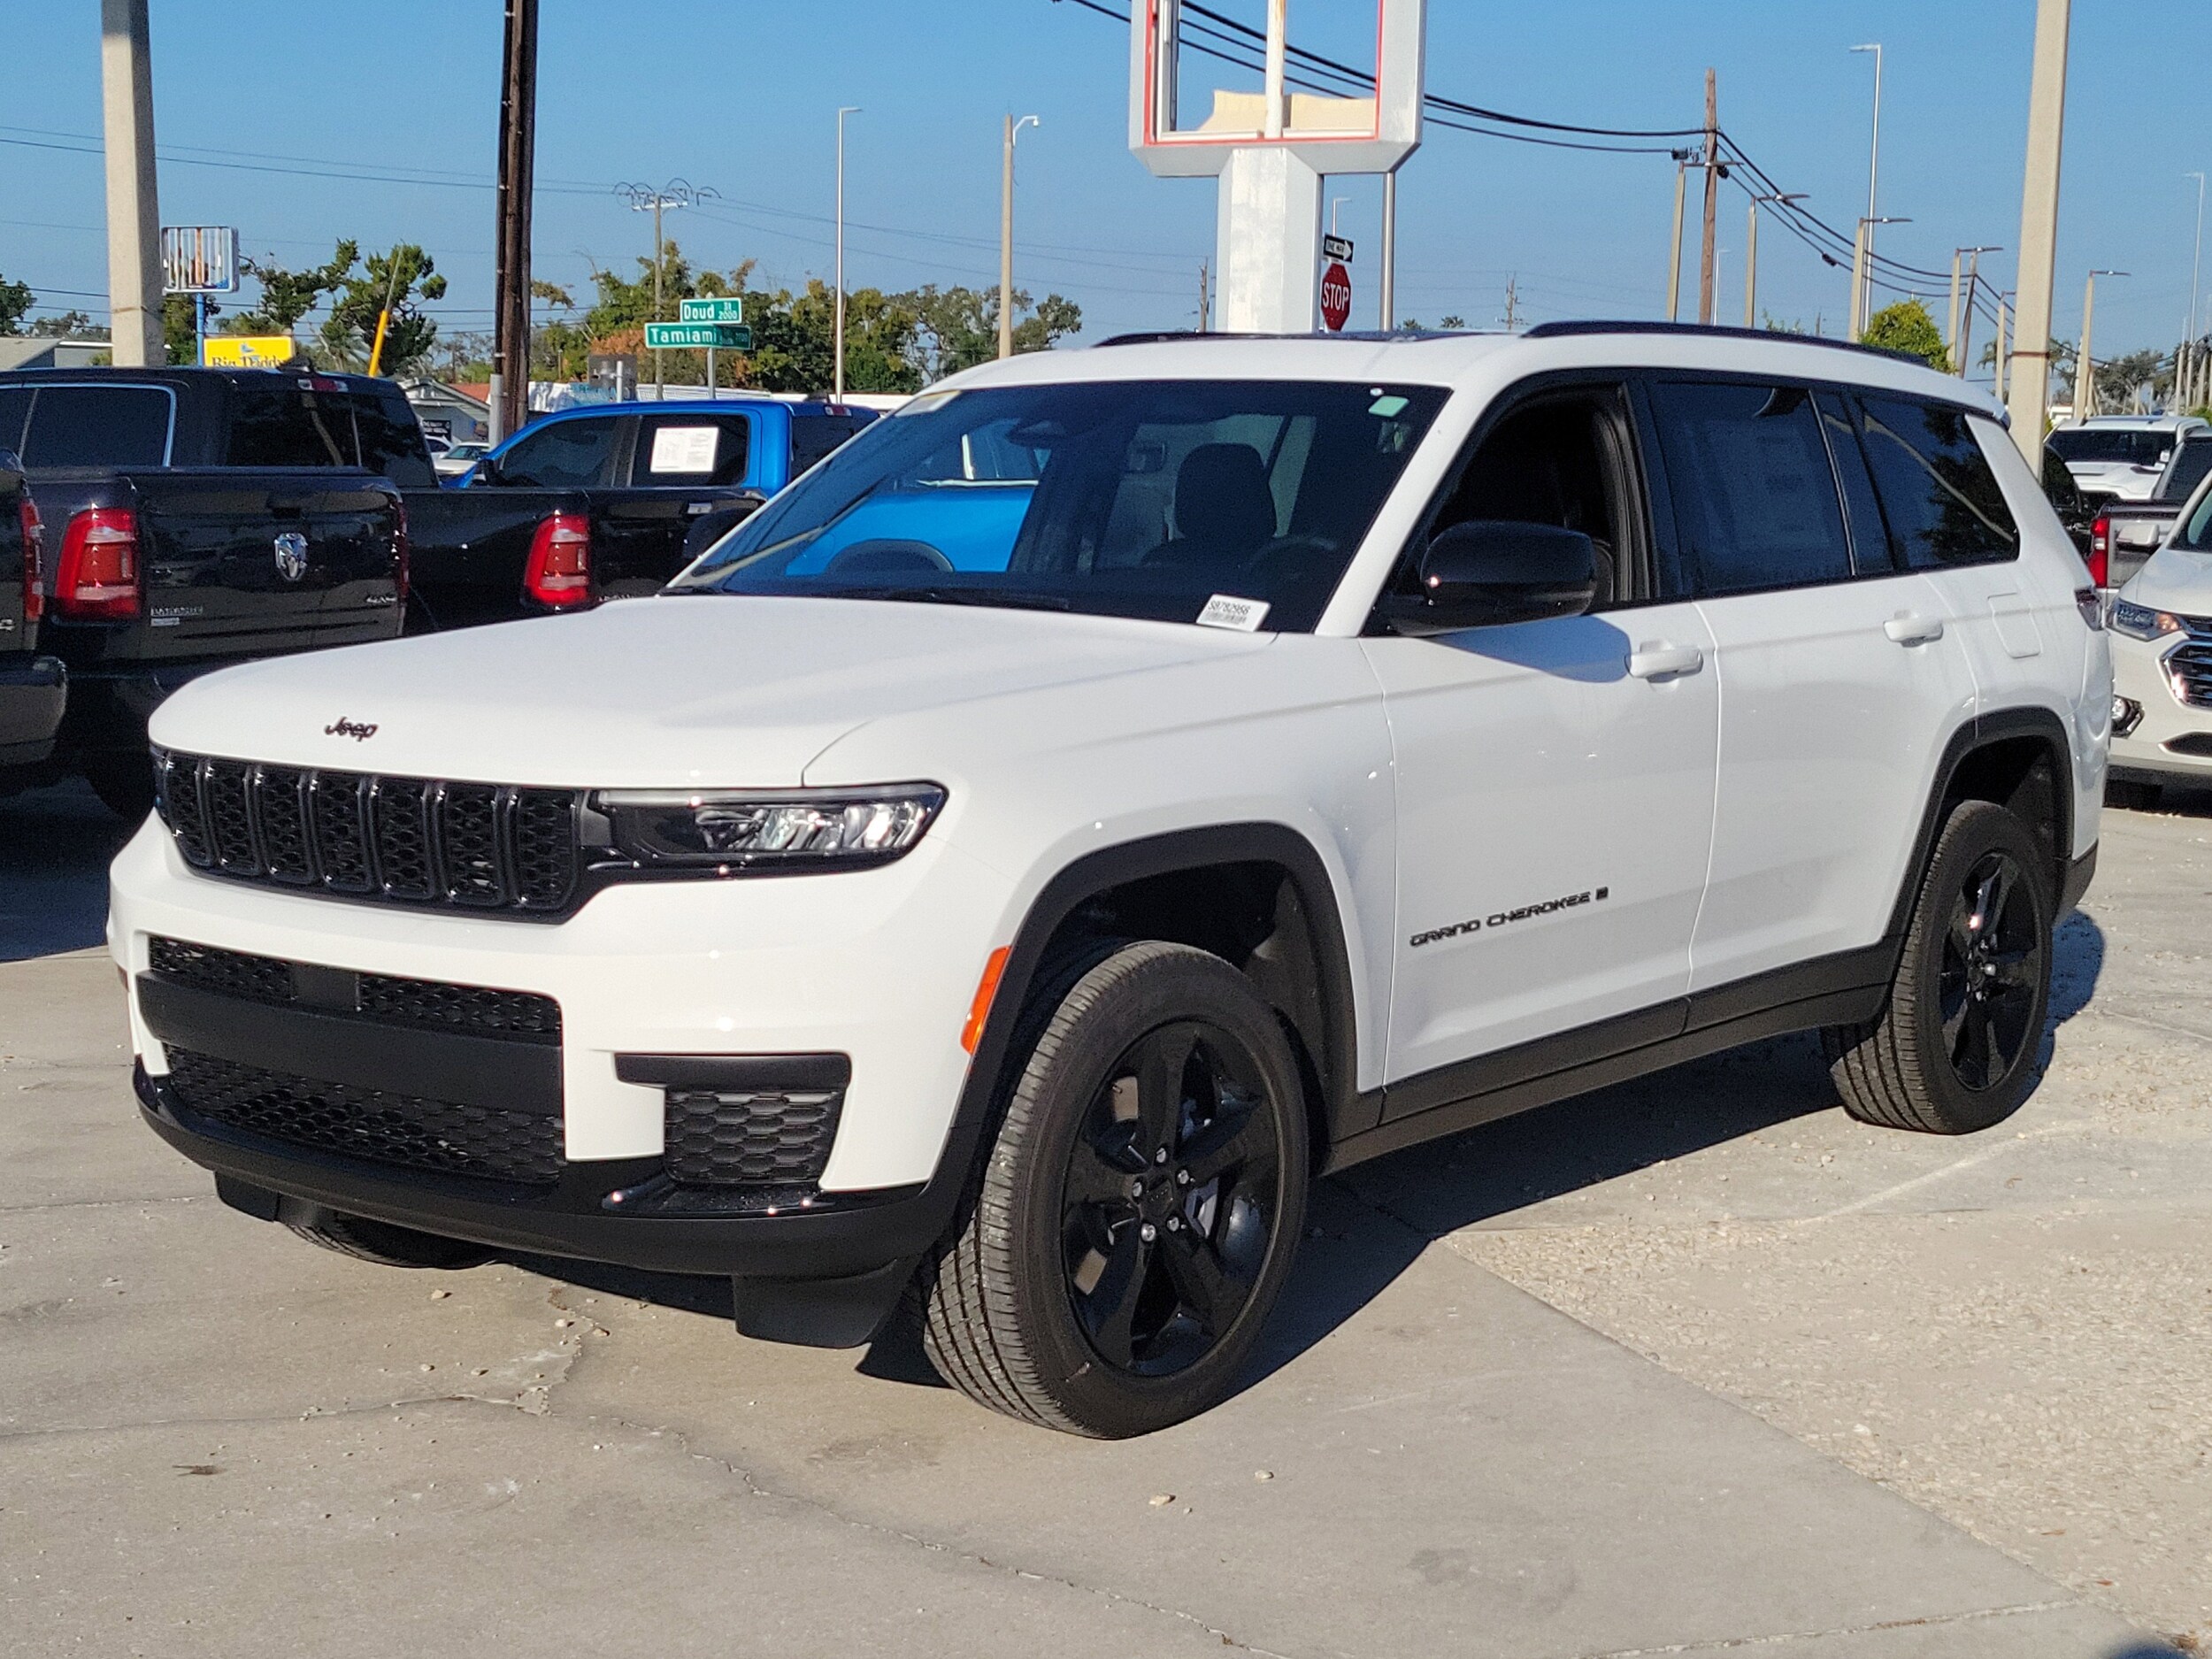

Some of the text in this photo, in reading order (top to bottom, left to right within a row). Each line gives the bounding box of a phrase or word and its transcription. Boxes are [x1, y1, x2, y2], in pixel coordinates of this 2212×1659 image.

[1322, 282, 1349, 311] STOP
[683, 303, 715, 319] Doud
[650, 327, 717, 343] Tamiami
[324, 717, 379, 742] Jeep
[1409, 919, 1481, 947] GRAND
[1486, 891, 1591, 928] CHEROKEE
